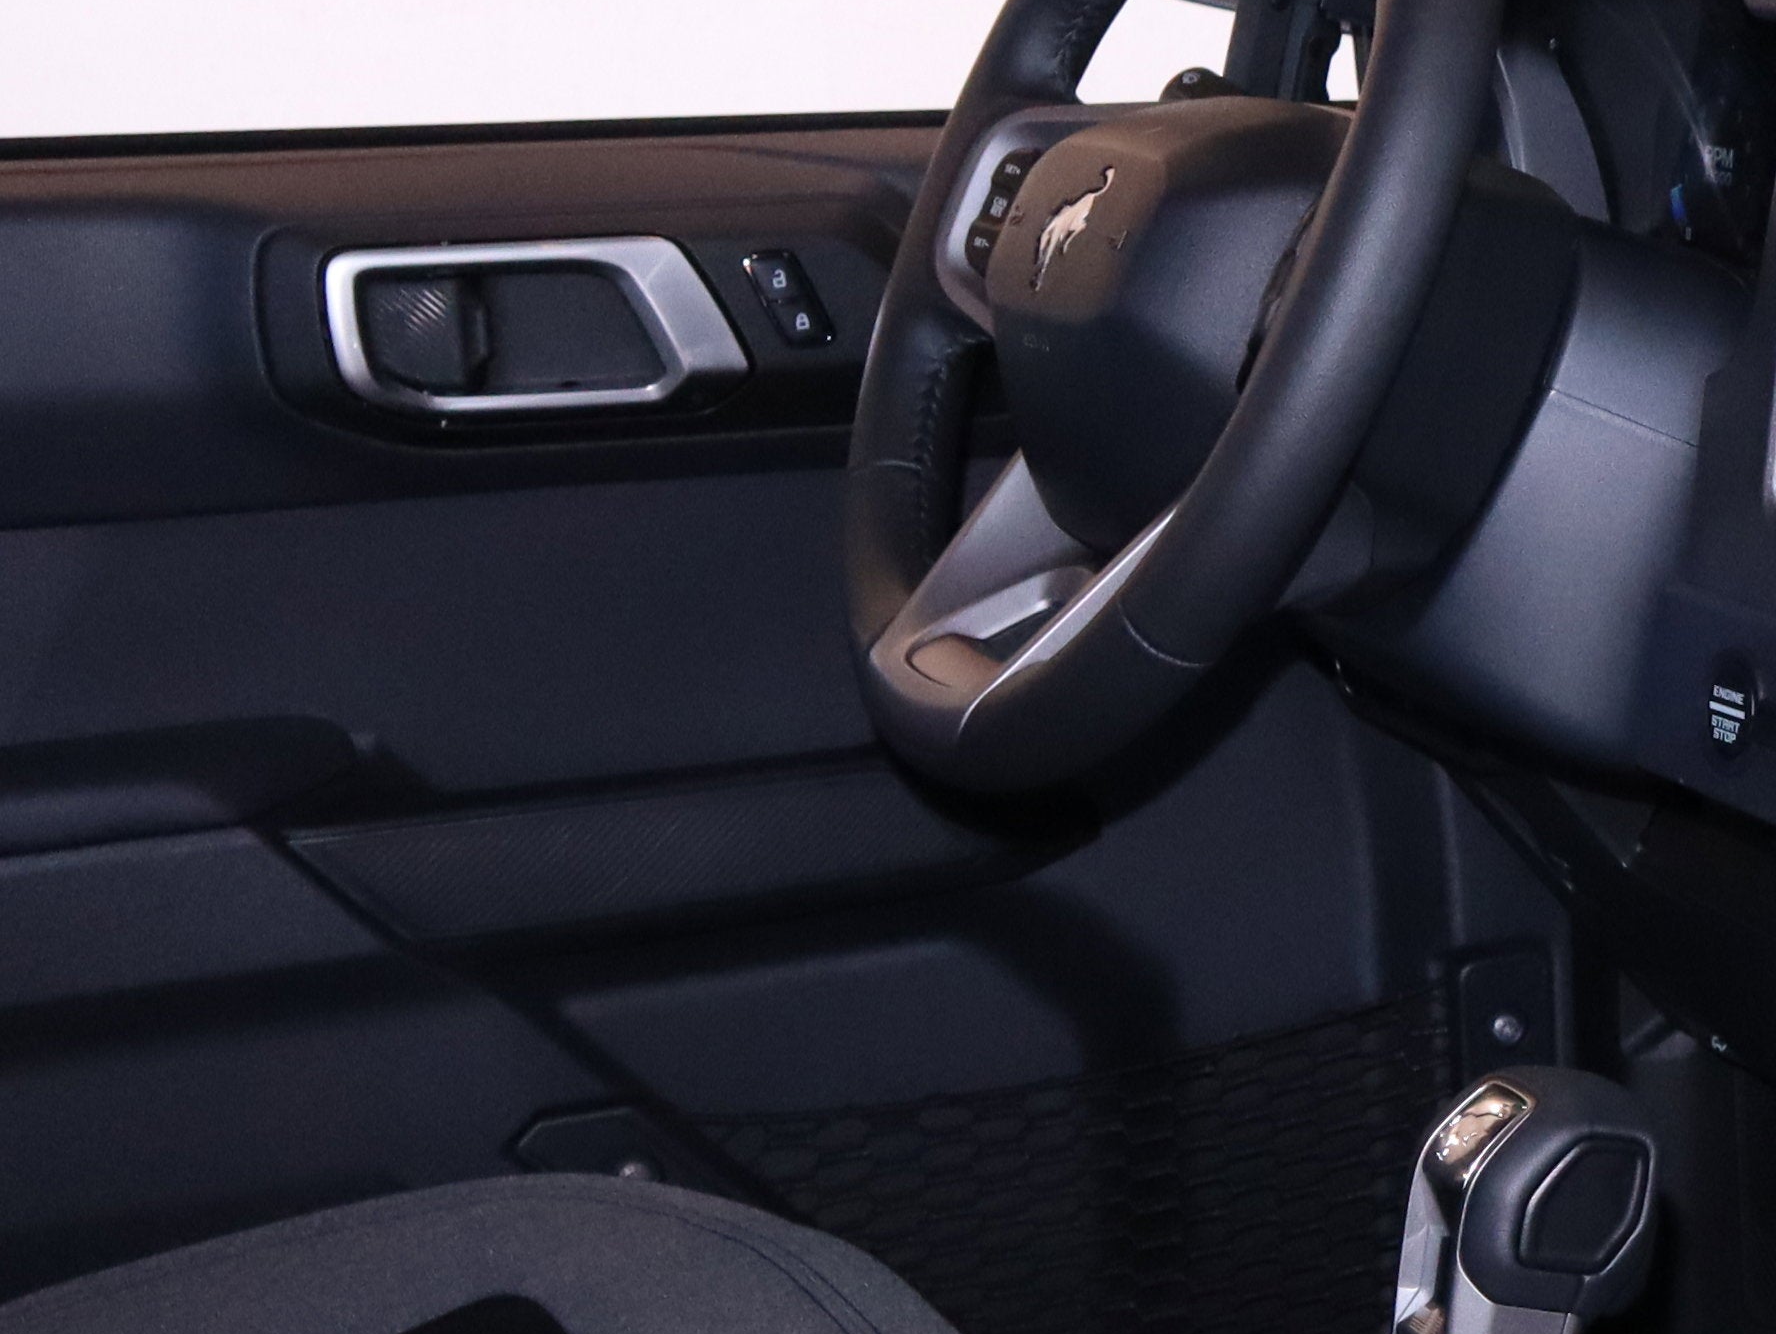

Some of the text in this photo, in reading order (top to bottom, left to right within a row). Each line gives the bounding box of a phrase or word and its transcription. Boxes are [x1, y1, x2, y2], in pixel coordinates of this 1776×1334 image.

[1713, 685, 1745, 706] ENGINE
[1711, 715, 1742, 735] START
[1712, 727, 1737, 746] STOP
